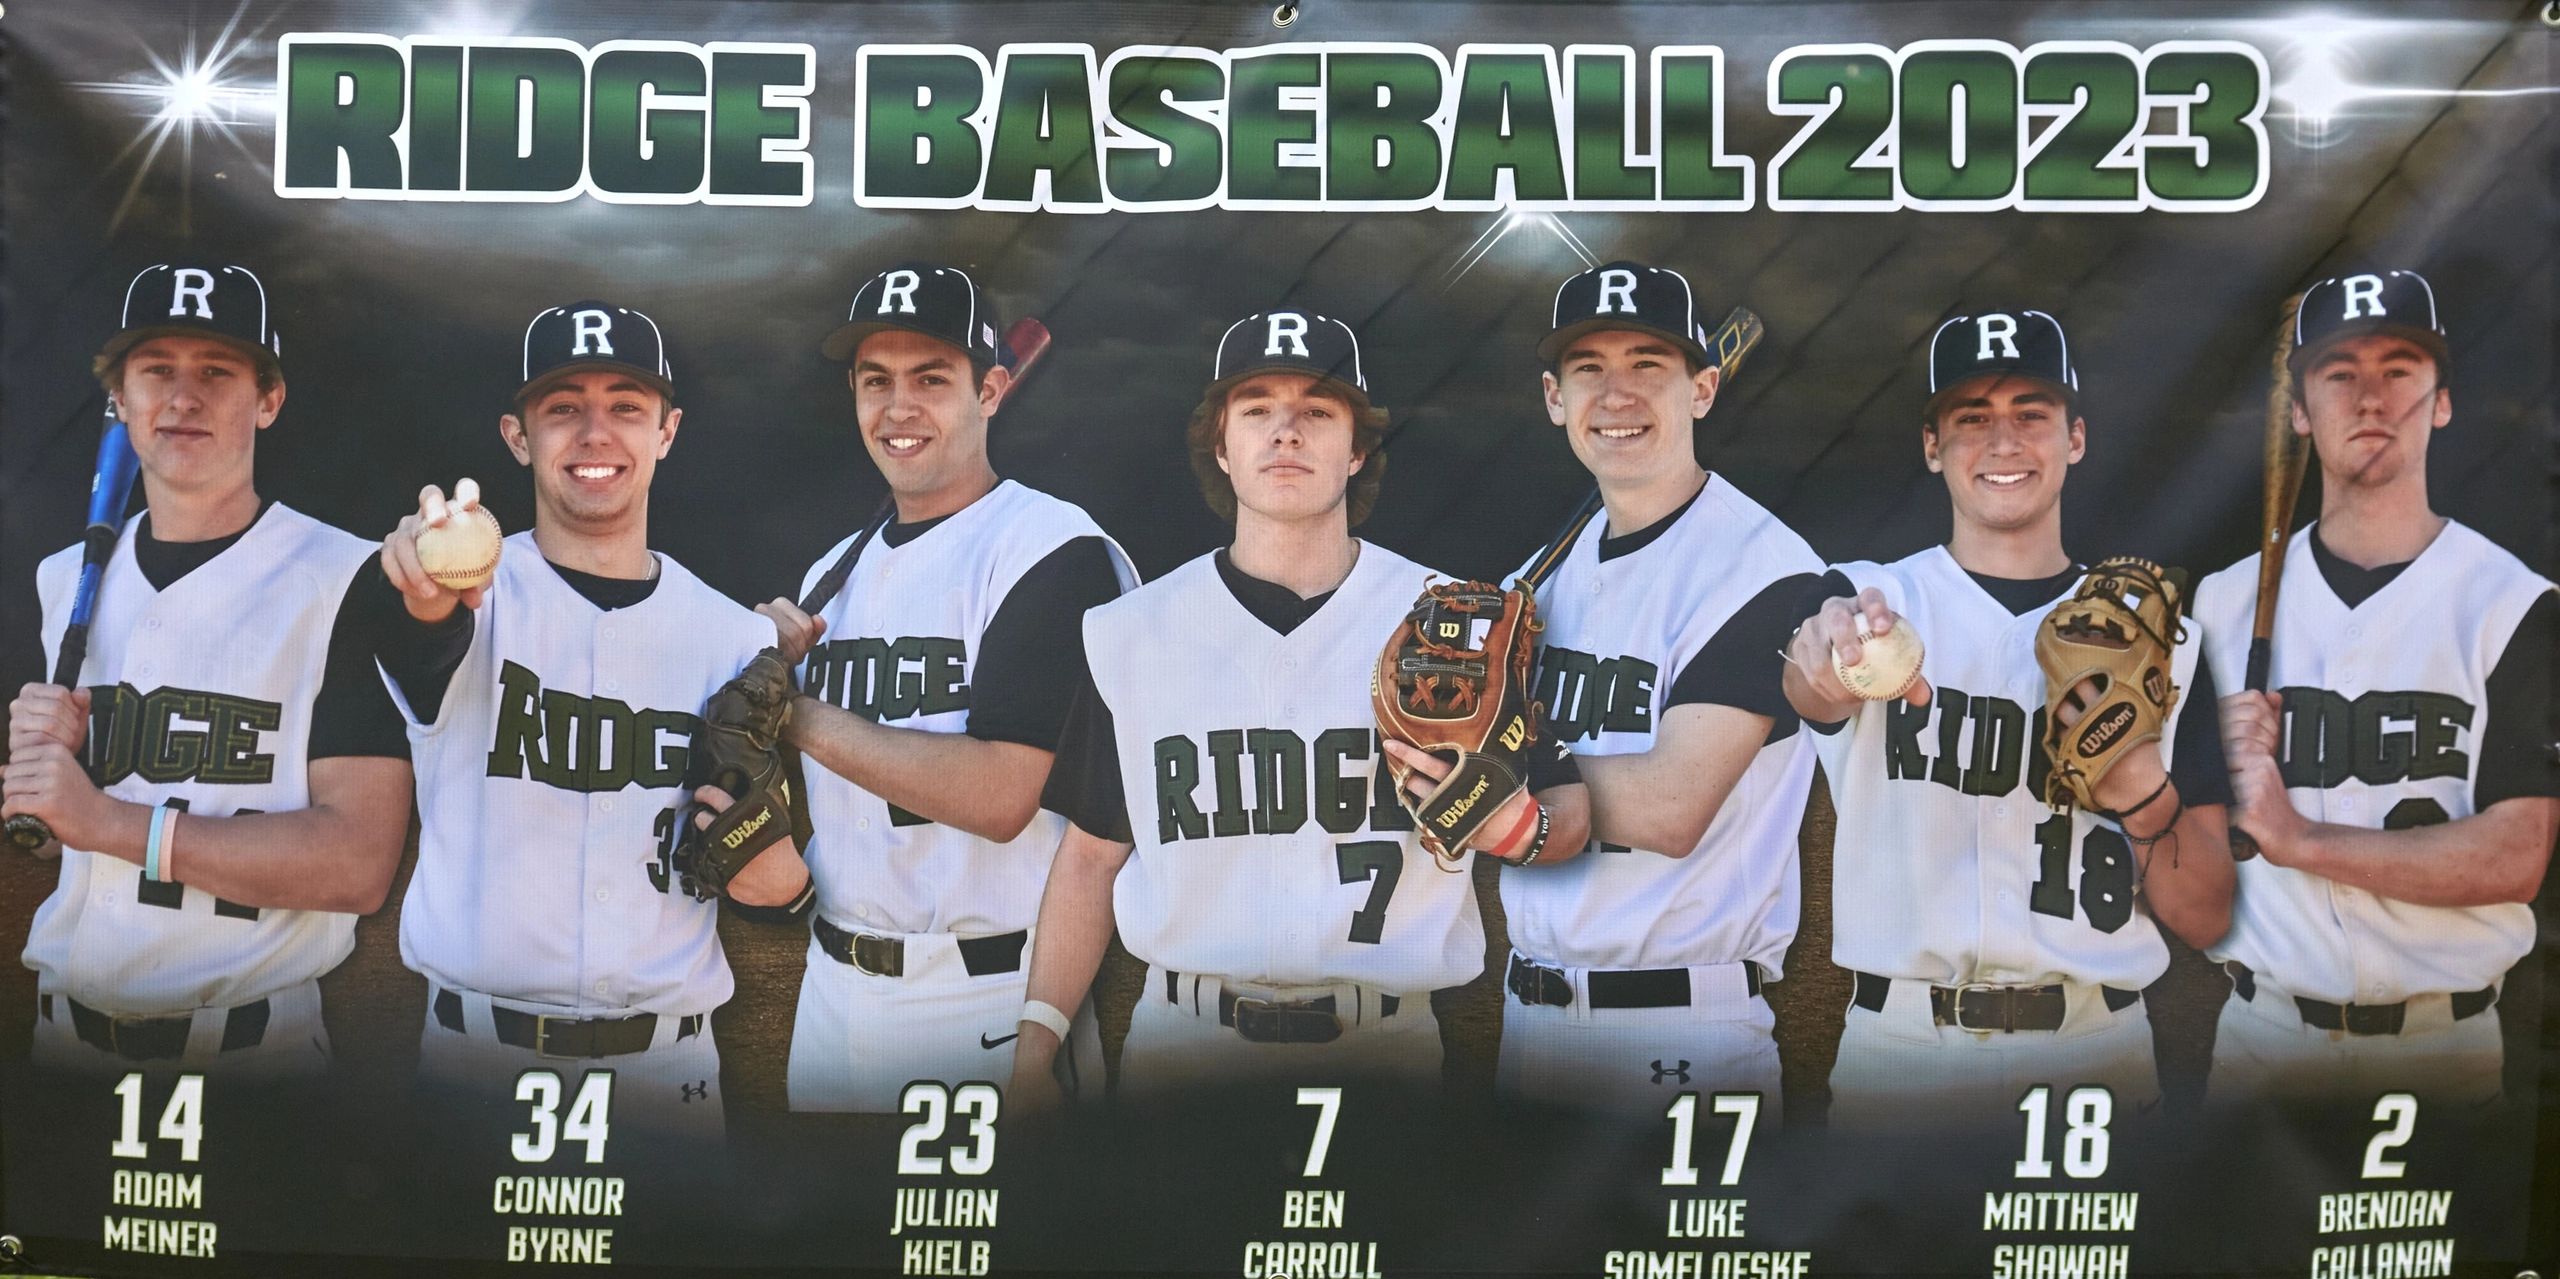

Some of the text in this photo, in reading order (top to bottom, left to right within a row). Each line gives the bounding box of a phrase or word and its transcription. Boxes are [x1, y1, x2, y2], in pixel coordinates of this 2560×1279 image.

[276, 34, 2271, 213] RIDGE BASEBALL 2023
[170, 269, 214, 319] R
[878, 270, 919, 314] R
[1596, 270, 1636, 314] R
[2343, 275, 2386, 320] R
[572, 310, 613, 355] R
[1265, 313, 1309, 357] R
[1977, 314, 2019, 360] R
[486, 659, 708, 793] RIDG
[2081, 705, 2134, 754] Wilson
[1436, 775, 1490, 829] Wilson
[722, 806, 773, 849] Wilson
[1541, 817, 1549, 835] YOU
[1336, 840, 1404, 944] 7
[2030, 813, 2135, 934] 18
[112, 1073, 204, 1162] 14
[511, 1072, 612, 1164] 34
[898, 1085, 999, 1175] 23
[1297, 1087, 1342, 1177] 7
[2014, 1087, 2113, 1179] 18
[2361, 1094, 2418, 1179] 2
[1661, 1095, 1759, 1186] 17
[113, 1170, 202, 1209] ADAM
[494, 1176, 625, 1216] CONNOR
[890, 1188, 999, 1235] JULIAN
[1283, 1190, 1345, 1228] BEN
[1983, 1192, 2139, 1231] MATTHEW
[2319, 1190, 2452, 1233] BRENDAN
[104, 1216, 217, 1258] MEINER
[1667, 1199, 1747, 1238] LUKE
[507, 1227, 613, 1264] BYRNE
[903, 1240, 990, 1276] KIELB
[1243, 1241, 1382, 1279] CARROLL
[1993, 1245, 2130, 1279] SHAWAH
[2311, 1239, 2455, 1279] CALLANAN
